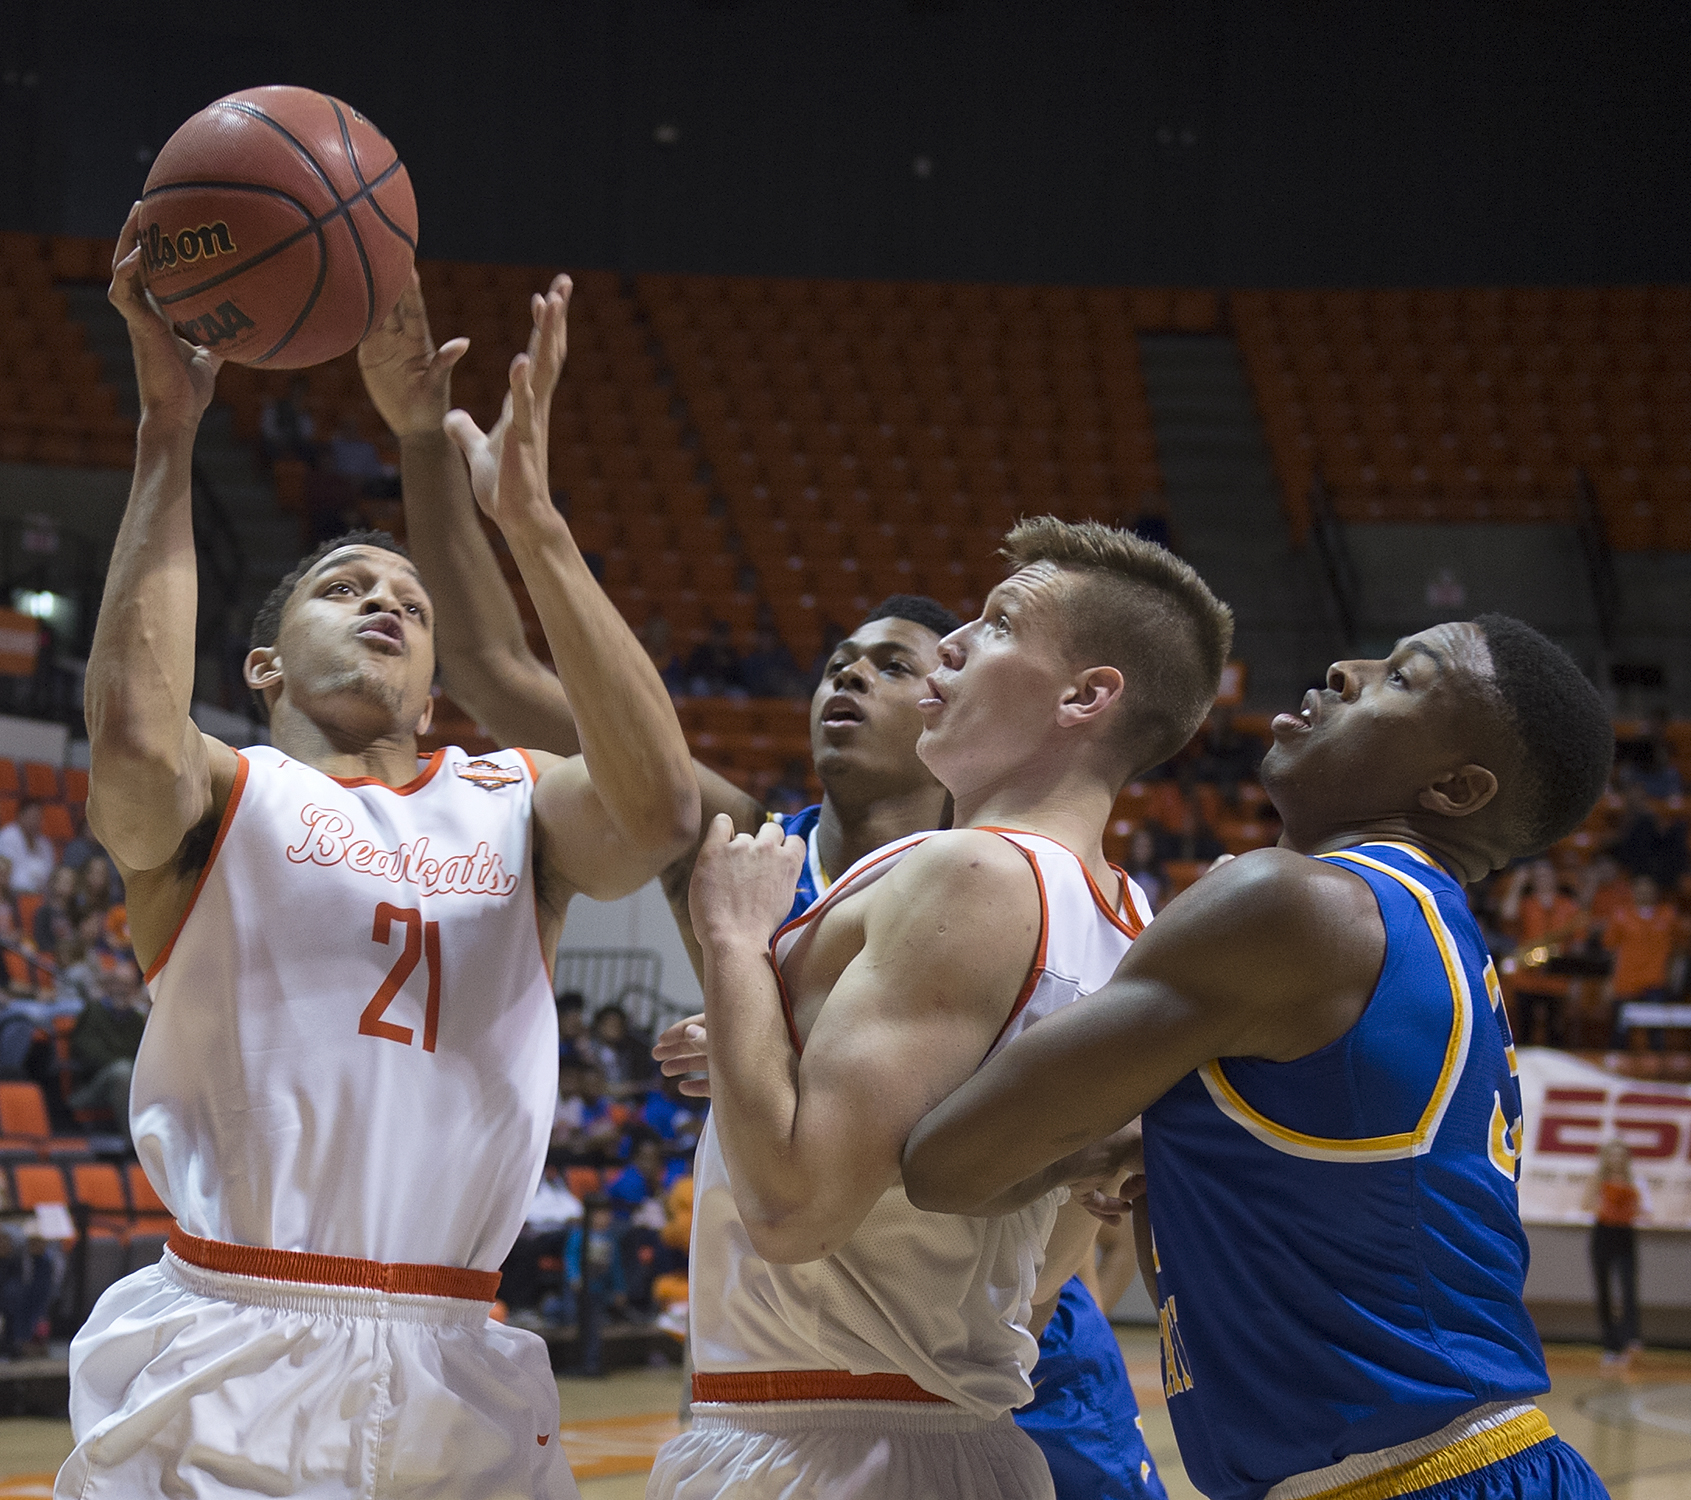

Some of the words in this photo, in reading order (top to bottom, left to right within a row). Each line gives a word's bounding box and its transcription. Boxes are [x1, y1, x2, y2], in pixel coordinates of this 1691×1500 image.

[140, 220, 237, 272] ilson
[174, 299, 255, 346] CAA
[358, 901, 441, 1053] 21
[1536, 1087, 1691, 1161] ES
